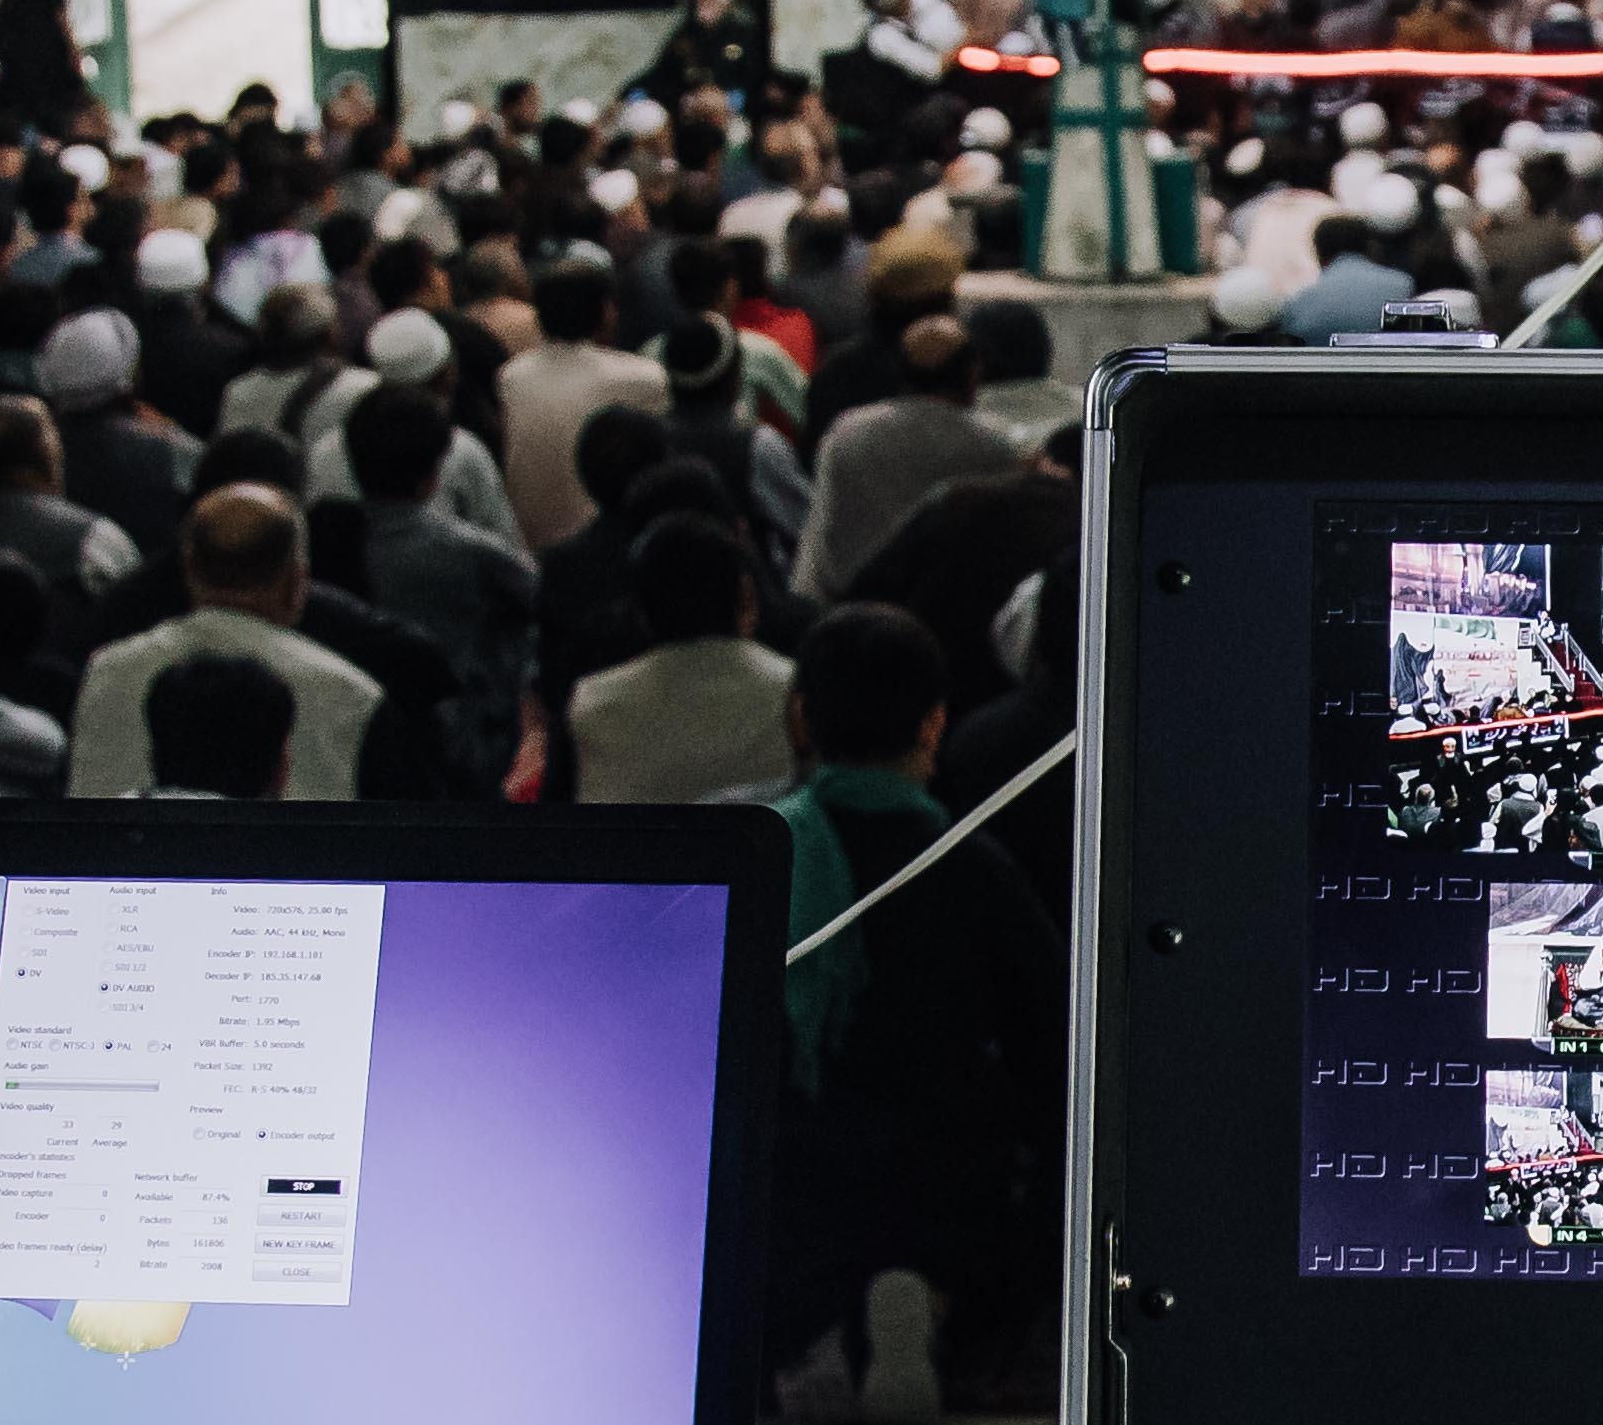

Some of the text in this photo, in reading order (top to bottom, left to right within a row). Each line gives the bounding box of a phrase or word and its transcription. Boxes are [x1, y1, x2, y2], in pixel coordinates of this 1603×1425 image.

[23, 887, 70, 896] Video input
[109, 887, 157, 896] Audio input
[211, 887, 228, 896] Info
[335, 906, 349, 917] fps
[322, 929, 345, 937] Mono
[208, 950, 242, 959] Encoder
[205, 972, 240, 981] Decoder
[8, 1026, 72, 1035] Video standard
[116, 1042, 133, 1051] PAL
[270, 1041, 305, 1049] seconds
[1560, 1042, 1579, 1054] IN
[1581, 1042, 1589, 1054] 1
[4, 1061, 50, 1072] Audio gain
[194, 1062, 222, 1071] Packet
[0, 1103, 55, 1113] Video quality
[189, 1106, 224, 1115] Preview
[47, 1138, 128, 1149] Current Average
[36, 1170, 67, 1180] frames
[134, 1173, 170, 1182] Network
[292, 1181, 316, 1191] STOP
[280, 1211, 323, 1221] RESTART
[1556, 1230, 1574, 1243] IN
[1575, 1230, 1588, 1243] 4
[263, 1239, 336, 1250] NEW KEY FRAME
[1308, 1244, 1385, 1272] HD
[1401, 1245, 1477, 1273] HD
[282, 1268, 311, 1277] CLOSE
